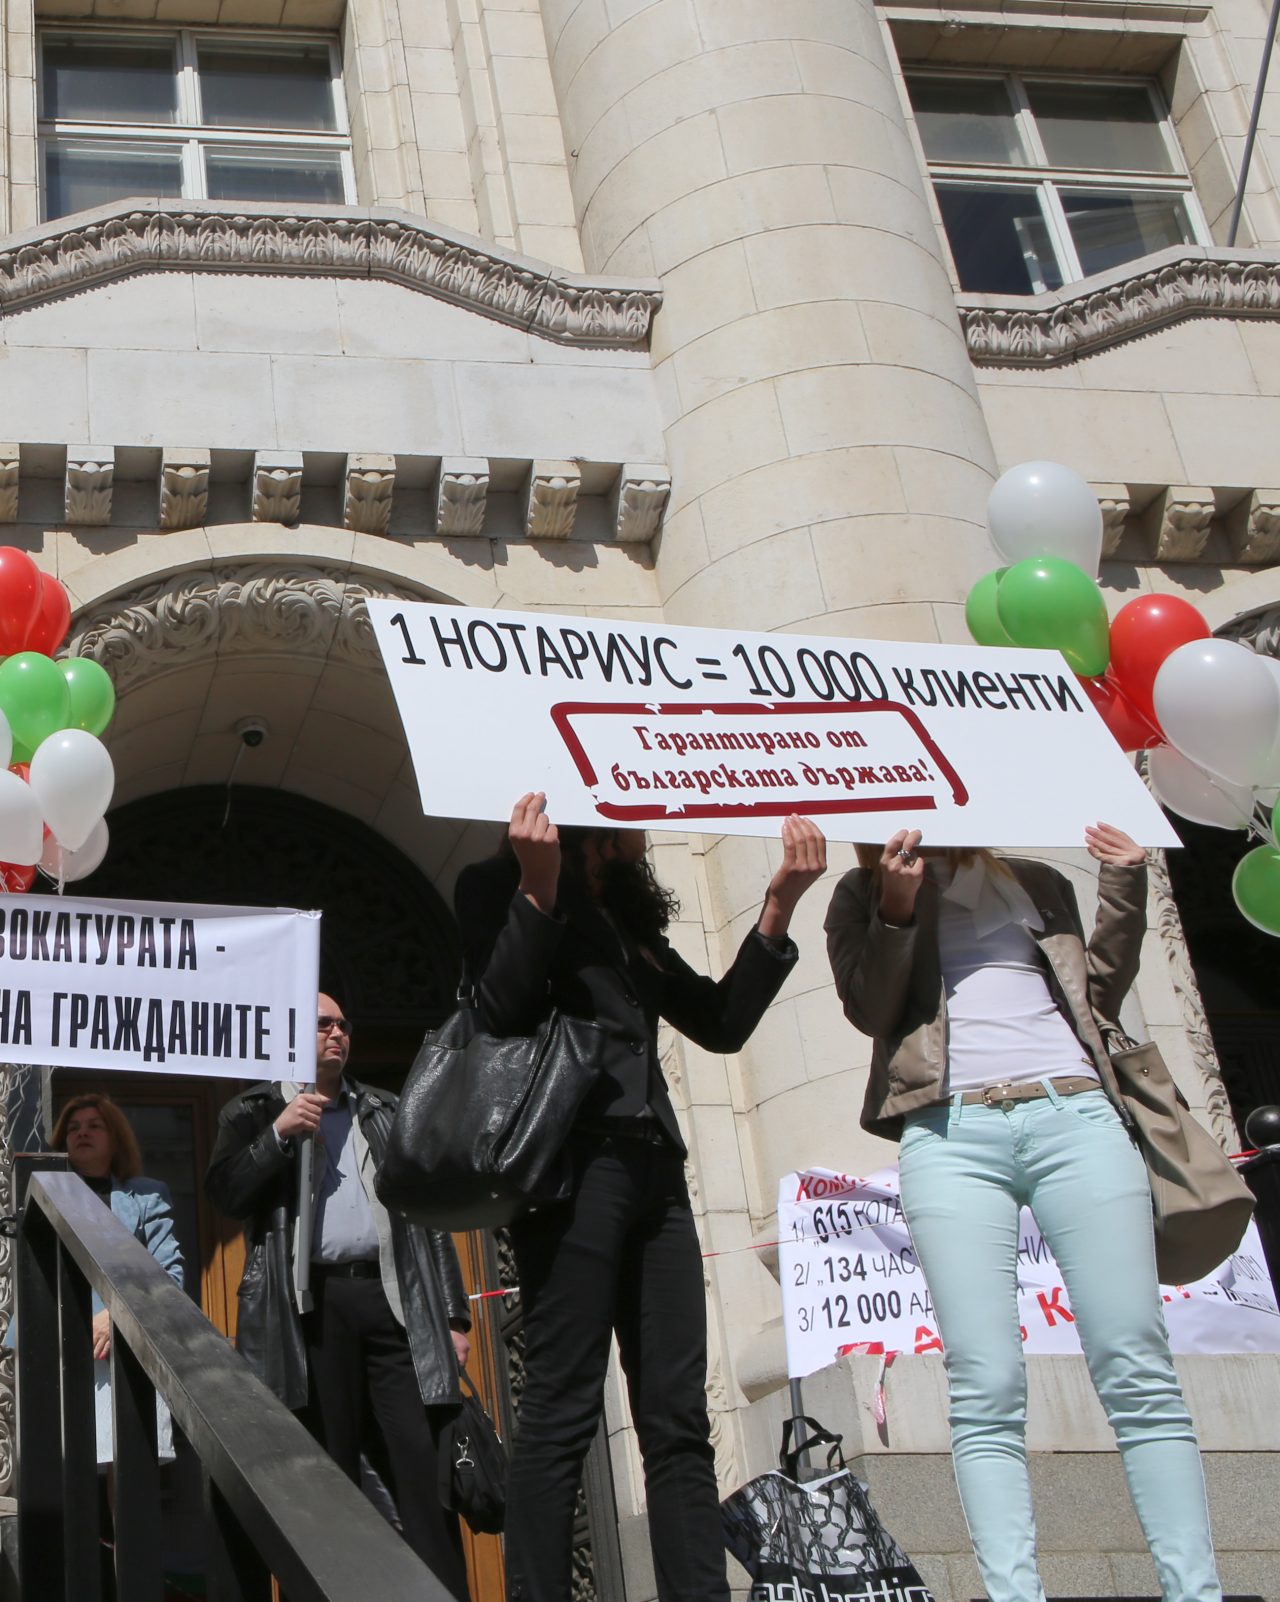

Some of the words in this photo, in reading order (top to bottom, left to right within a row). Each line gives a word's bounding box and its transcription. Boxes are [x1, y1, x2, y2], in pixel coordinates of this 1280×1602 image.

[390, 612, 426, 666] 1
[429, 616, 693, 690] НОТАРИУС
[695, 657, 728, 681] =
[732, 643, 796, 698] 10
[796, 647, 889, 702] 000
[891, 666, 1084, 713] клиенти
[632, 726, 821, 756] Гарантирано
[826, 729, 868, 748] от
[611, 762, 799, 795] българската
[797, 758, 935, 791] държава!
[51, 990, 270, 1063] ГРАЖДАНИТЕ
[794, 1262, 810, 1287] 2/
[872, 1246, 916, 1278] ЧАС
[798, 1306, 815, 1332] 3/
[822, 1294, 851, 1329] 12
[857, 1290, 901, 1325] 000
